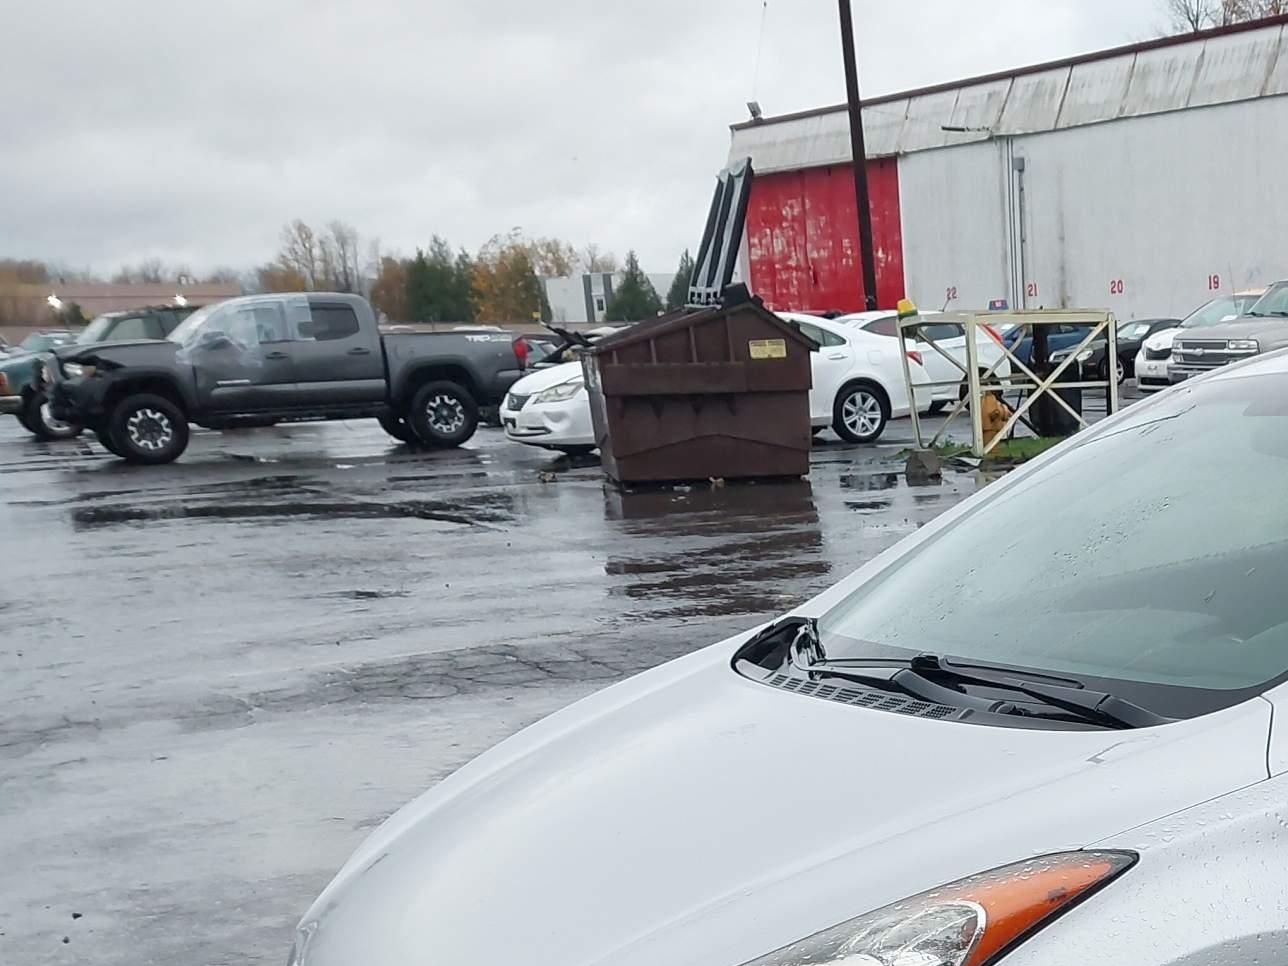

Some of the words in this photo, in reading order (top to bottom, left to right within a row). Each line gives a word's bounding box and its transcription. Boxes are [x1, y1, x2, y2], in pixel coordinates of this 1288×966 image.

[1110, 279, 1124, 294] 20
[1208, 274, 1220, 290] 19
[1027, 283, 1038, 297] 21
